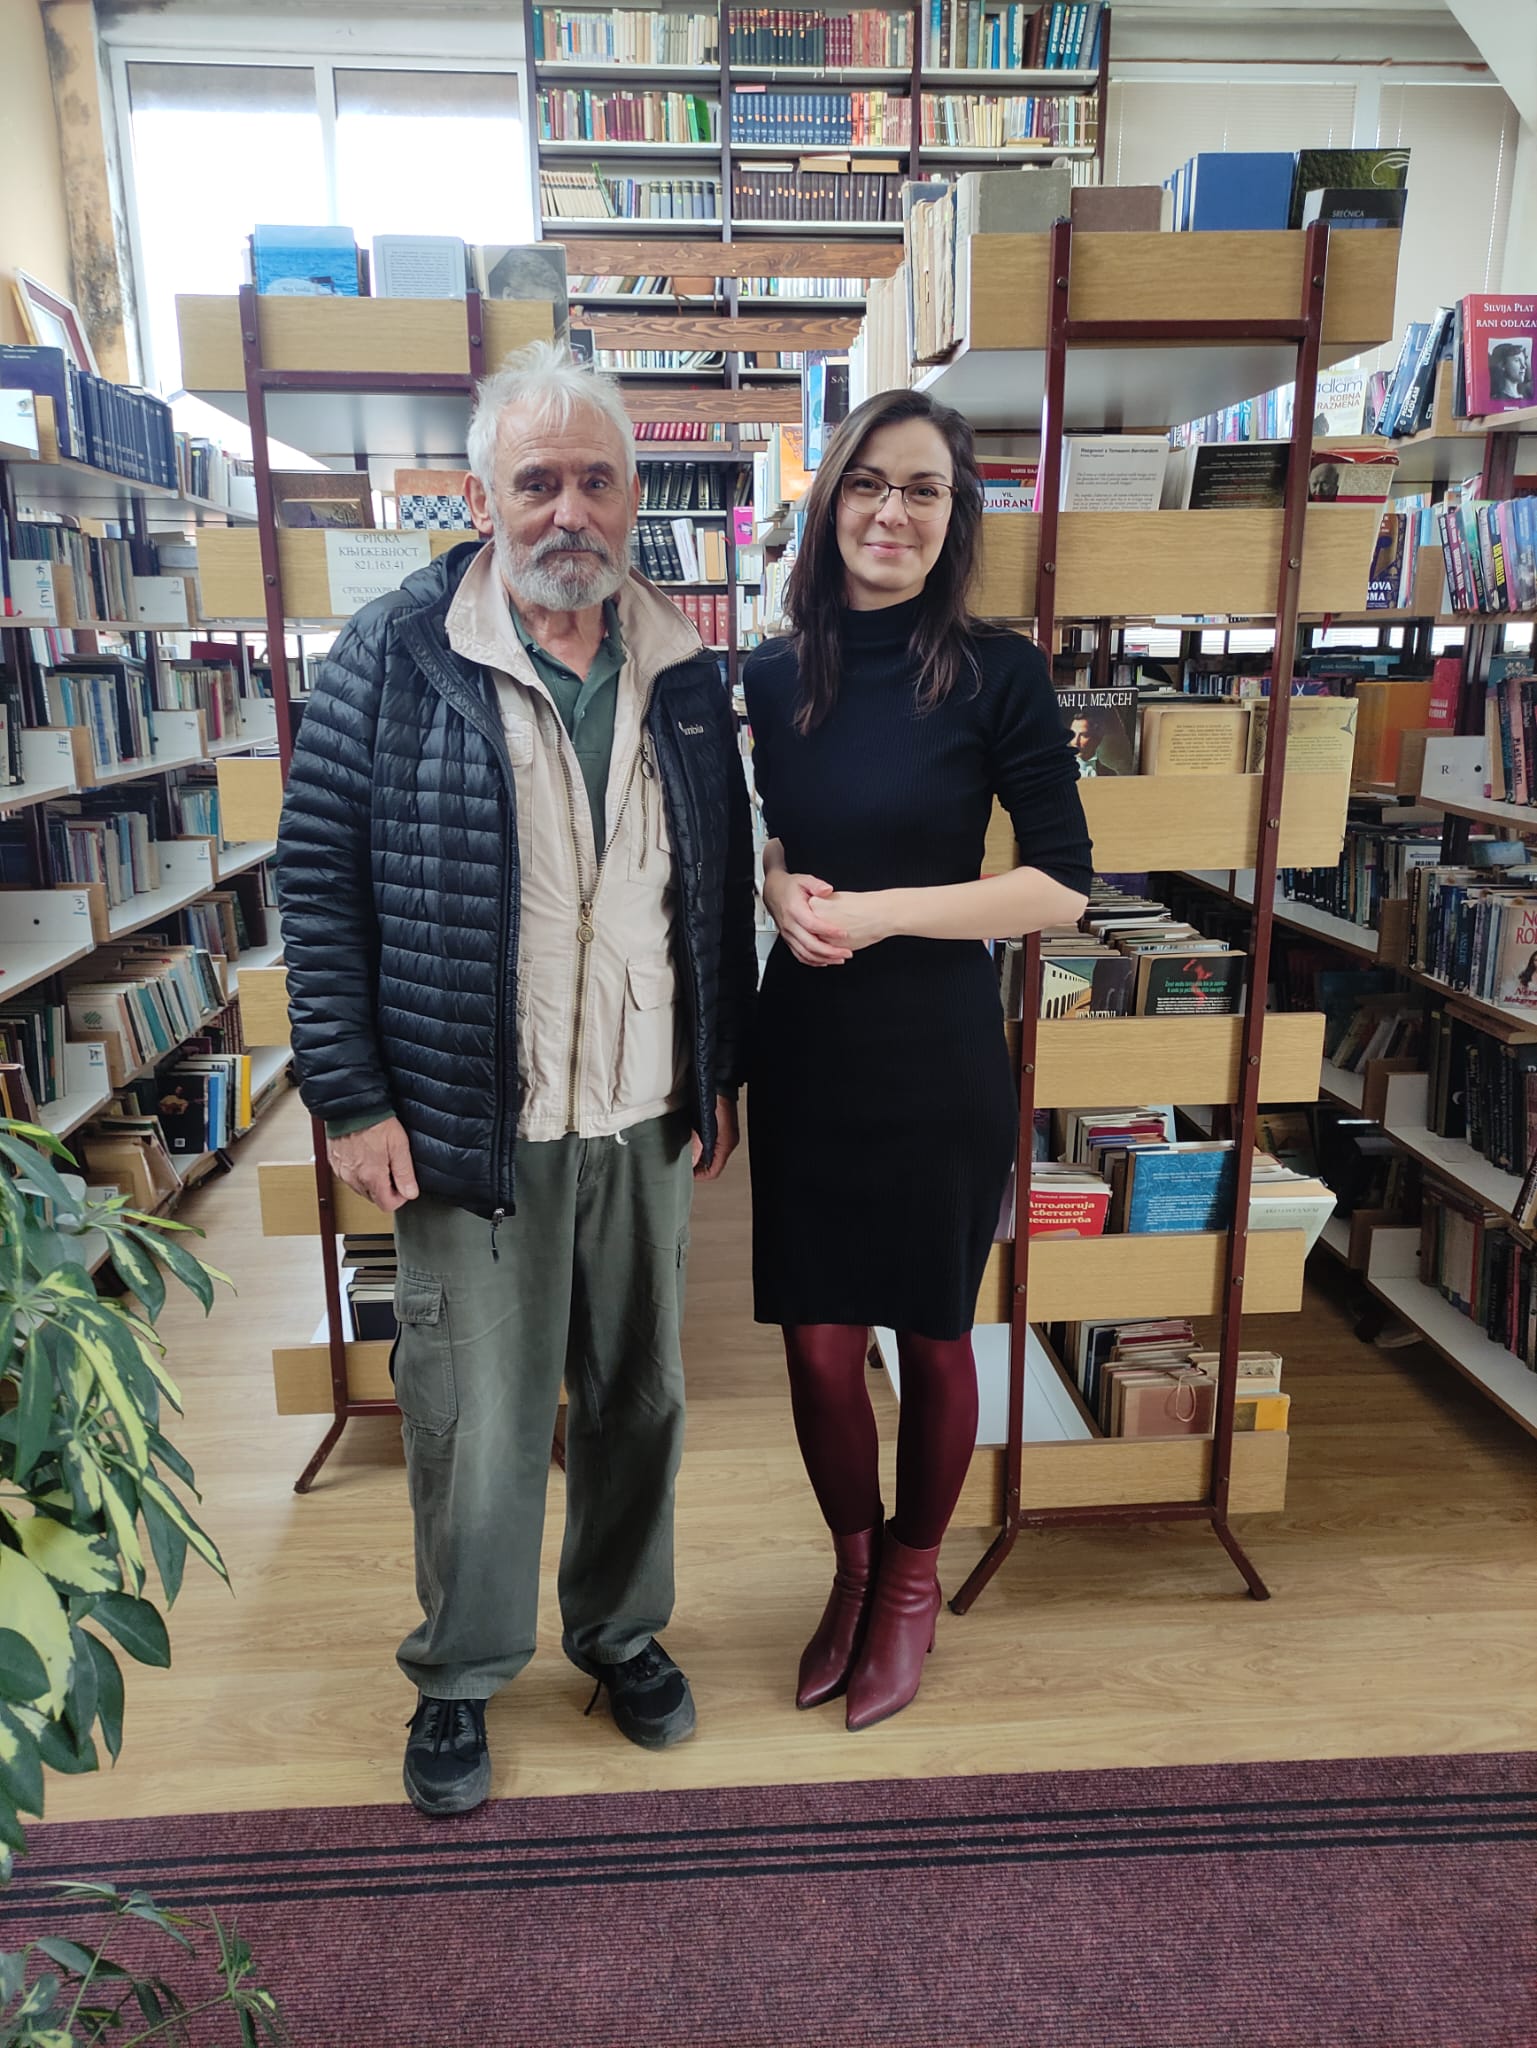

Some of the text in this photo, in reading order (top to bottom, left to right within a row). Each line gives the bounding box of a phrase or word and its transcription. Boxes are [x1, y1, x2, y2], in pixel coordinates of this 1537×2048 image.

[1484, 303, 1534, 312] SILVIJA PLAT
[1476, 319, 1537, 328] RANI ODLAZA
[1329, 393, 1361, 402] KOBNA
[984, 499, 1034, 508] DJURANT
[355, 534, 401, 544] СРПСКА
[338, 547, 419, 557] КЊИЖЕВНОСТ
[1090, 692, 1132, 709] МЕДСЕН
[1441, 764, 1450, 775] R
[1029, 1201, 1096, 1210] Антологија
